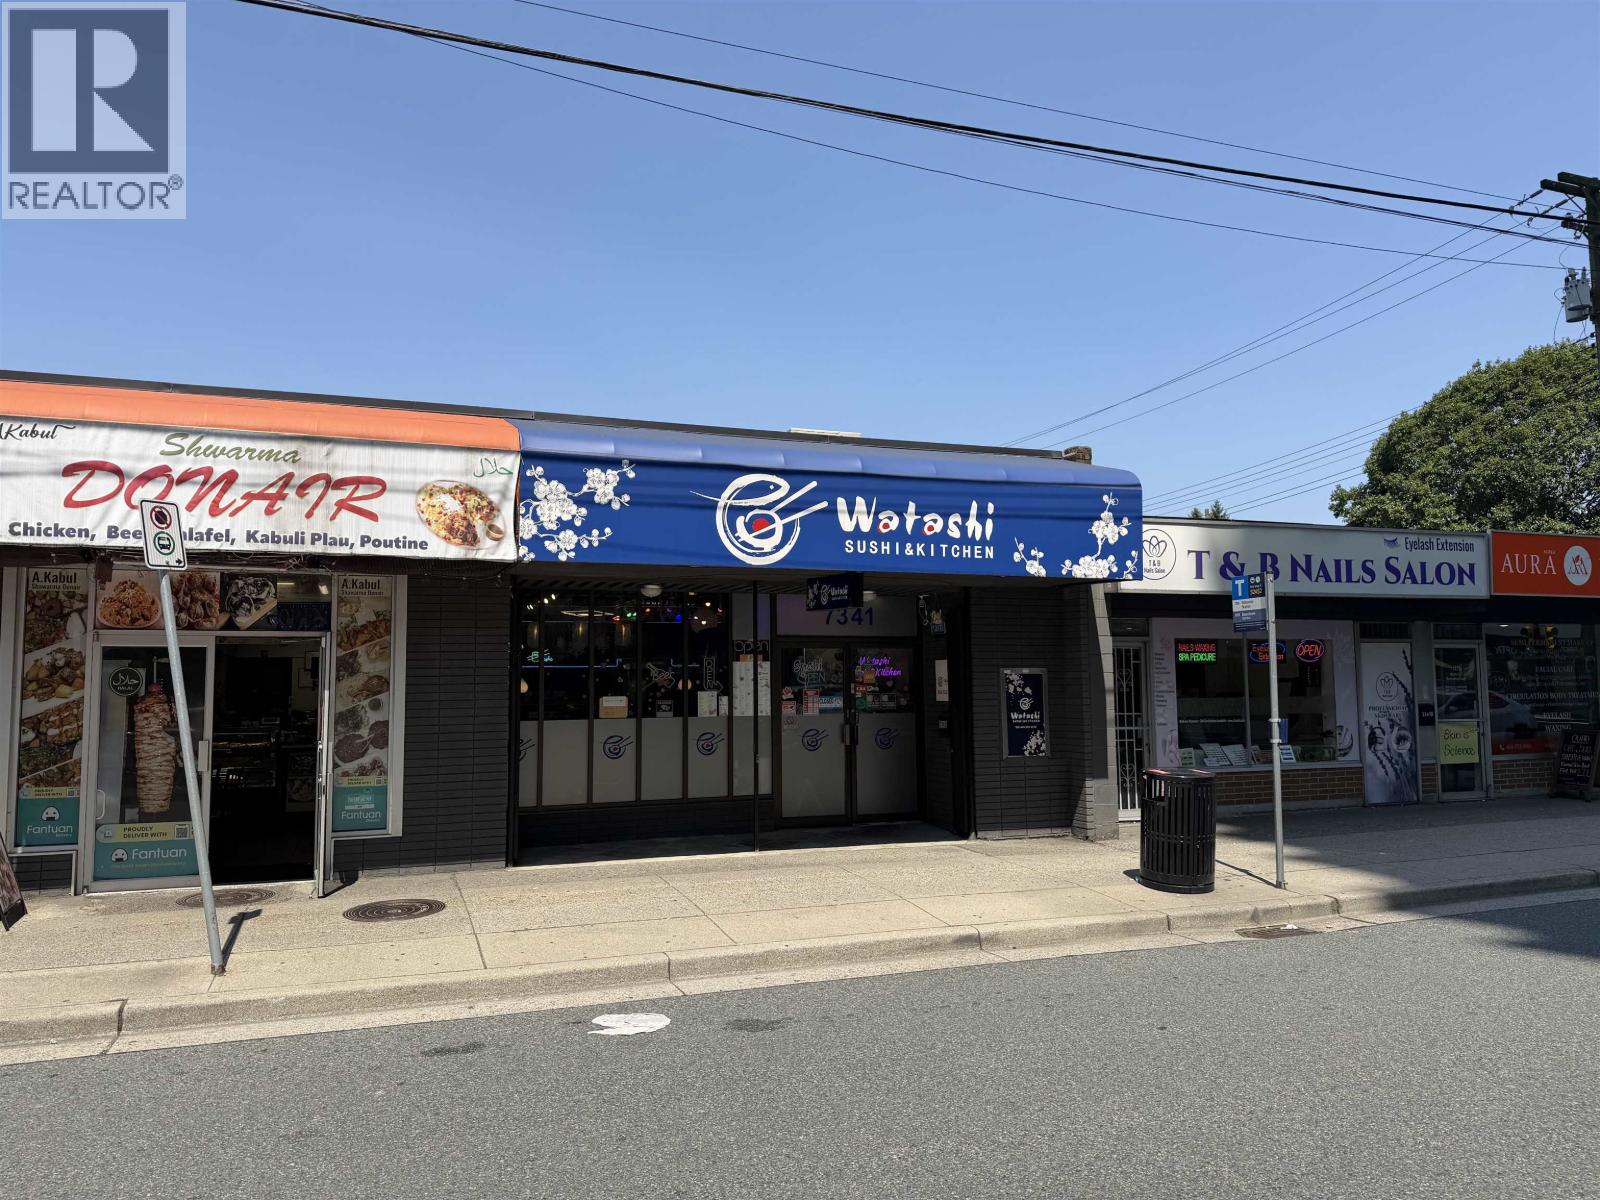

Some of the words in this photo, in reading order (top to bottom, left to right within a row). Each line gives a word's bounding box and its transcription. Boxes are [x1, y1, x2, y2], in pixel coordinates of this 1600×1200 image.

[159, 433, 301, 464] Shwarma
[473, 458, 513, 478] حلال
[62, 460, 387, 522] DONAIR
[836, 496, 994, 542] Watashi
[8, 522, 96, 541] Chicken,
[106, 525, 143, 540] Bee
[245, 530, 305, 545] Kabuli
[310, 532, 355, 549] Plau,
[359, 535, 429, 550] Poutine
[1405, 537, 1434, 552] Eyelash
[1436, 538, 1474, 553] Extension
[1187, 550, 1210, 579] T
[32, 571, 77, 584] A.Kabul
[342, 579, 380, 590] A.Kabul
[826, 607, 873, 625] 7341
[1298, 644, 1322, 657] OPEN
[341, 810, 381, 821] Fantuan
[26, 824, 73, 835] Fantuan
[132, 847, 187, 861] Fantuan
